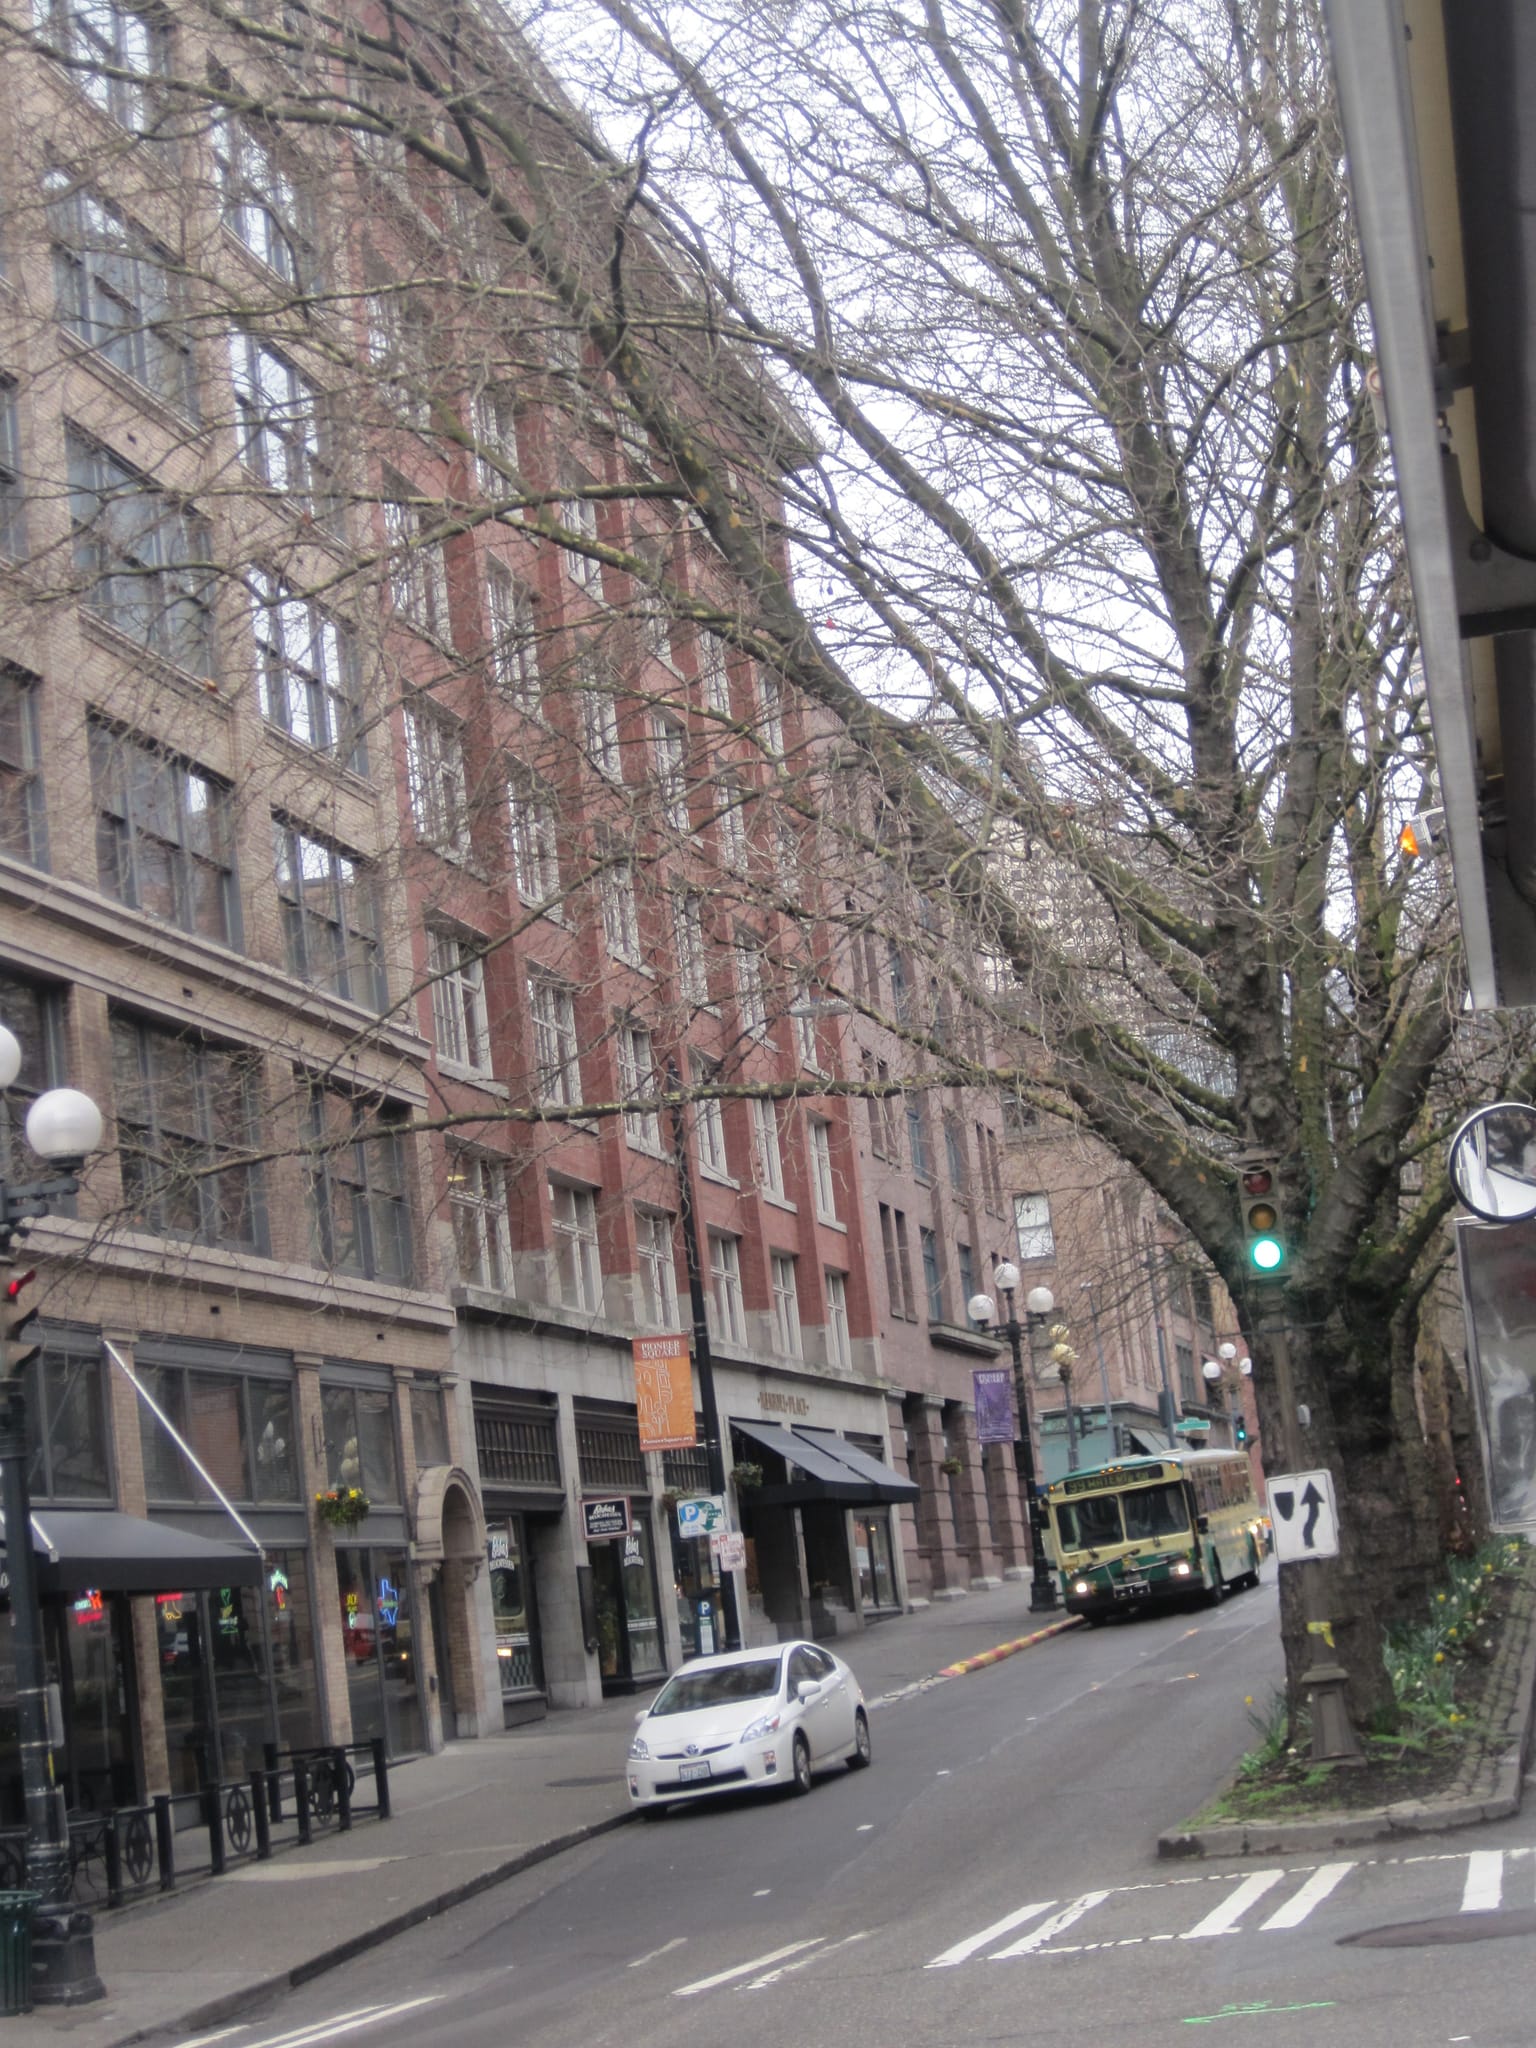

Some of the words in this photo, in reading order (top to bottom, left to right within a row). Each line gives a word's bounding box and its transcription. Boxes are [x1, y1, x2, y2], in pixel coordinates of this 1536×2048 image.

[641, 1340, 680, 1352] PIONEER
[642, 1348, 681, 1359] SQUARE
[684, 1506, 697, 1520] P
[701, 1601, 710, 1615] P
